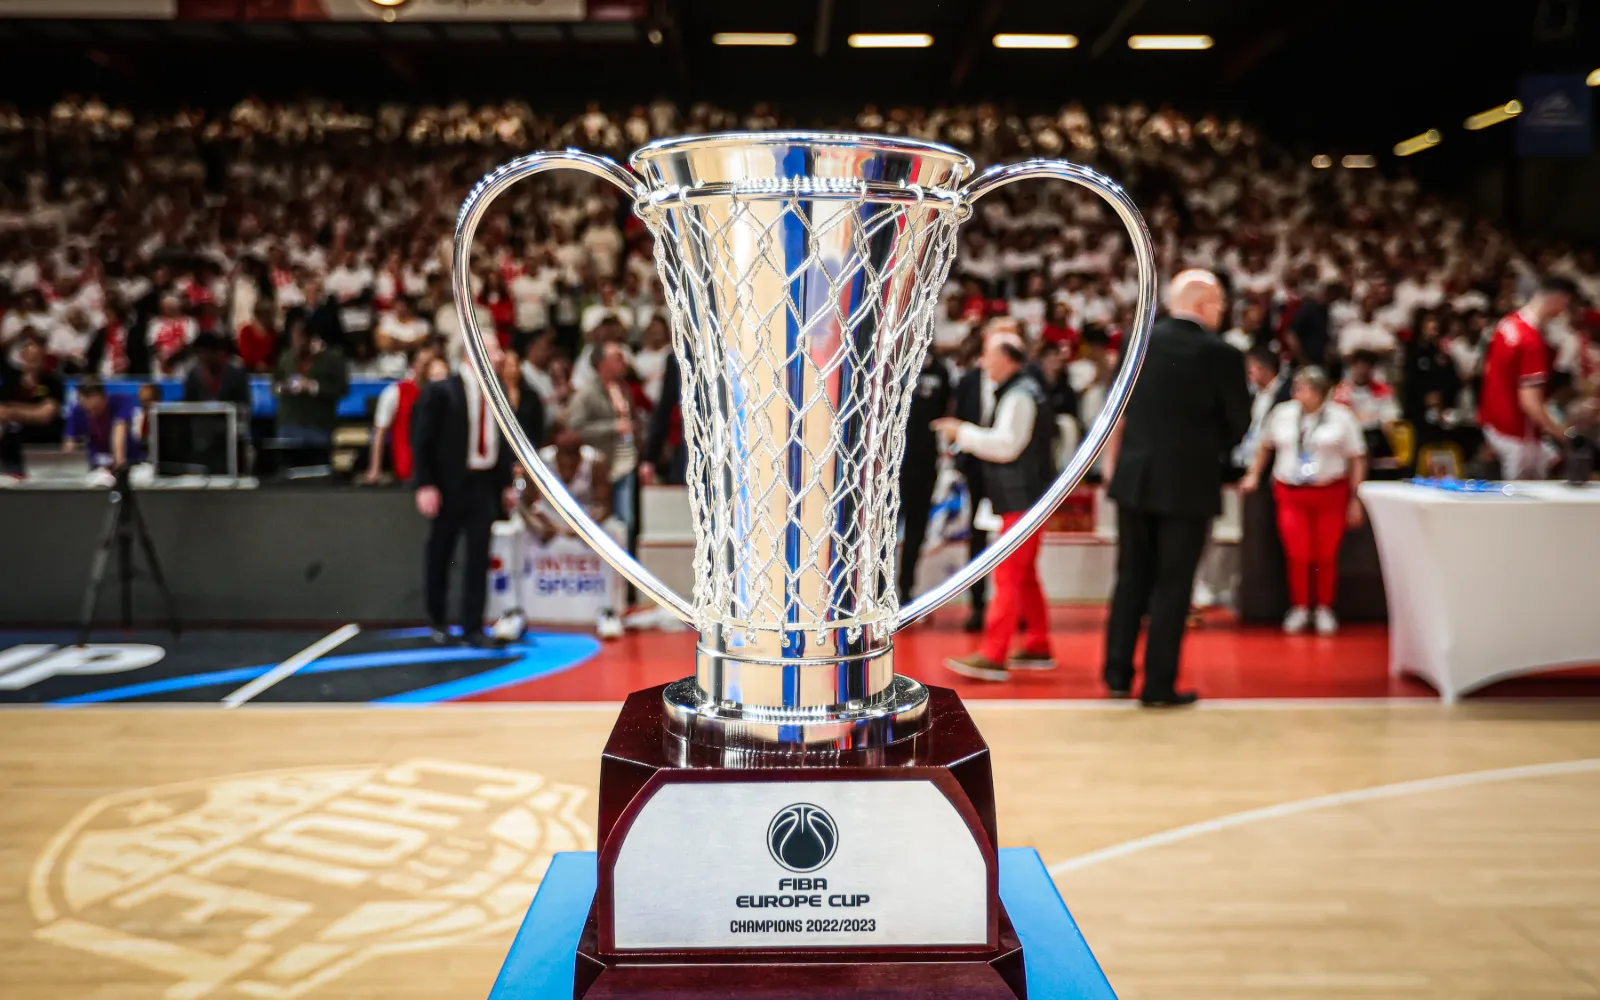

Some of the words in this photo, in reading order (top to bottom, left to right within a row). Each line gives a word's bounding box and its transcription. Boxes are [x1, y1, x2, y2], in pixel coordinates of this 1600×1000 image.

[536, 555, 602, 572] INTER
[537, 576, 605, 594] SPORT
[778, 877, 828, 891] FIBA
[735, 894, 822, 908] EUROPE
[828, 894, 871, 907] CUP
[730, 919, 803, 933] CHAMPIONS
[806, 918, 877, 932] 2022/2023
